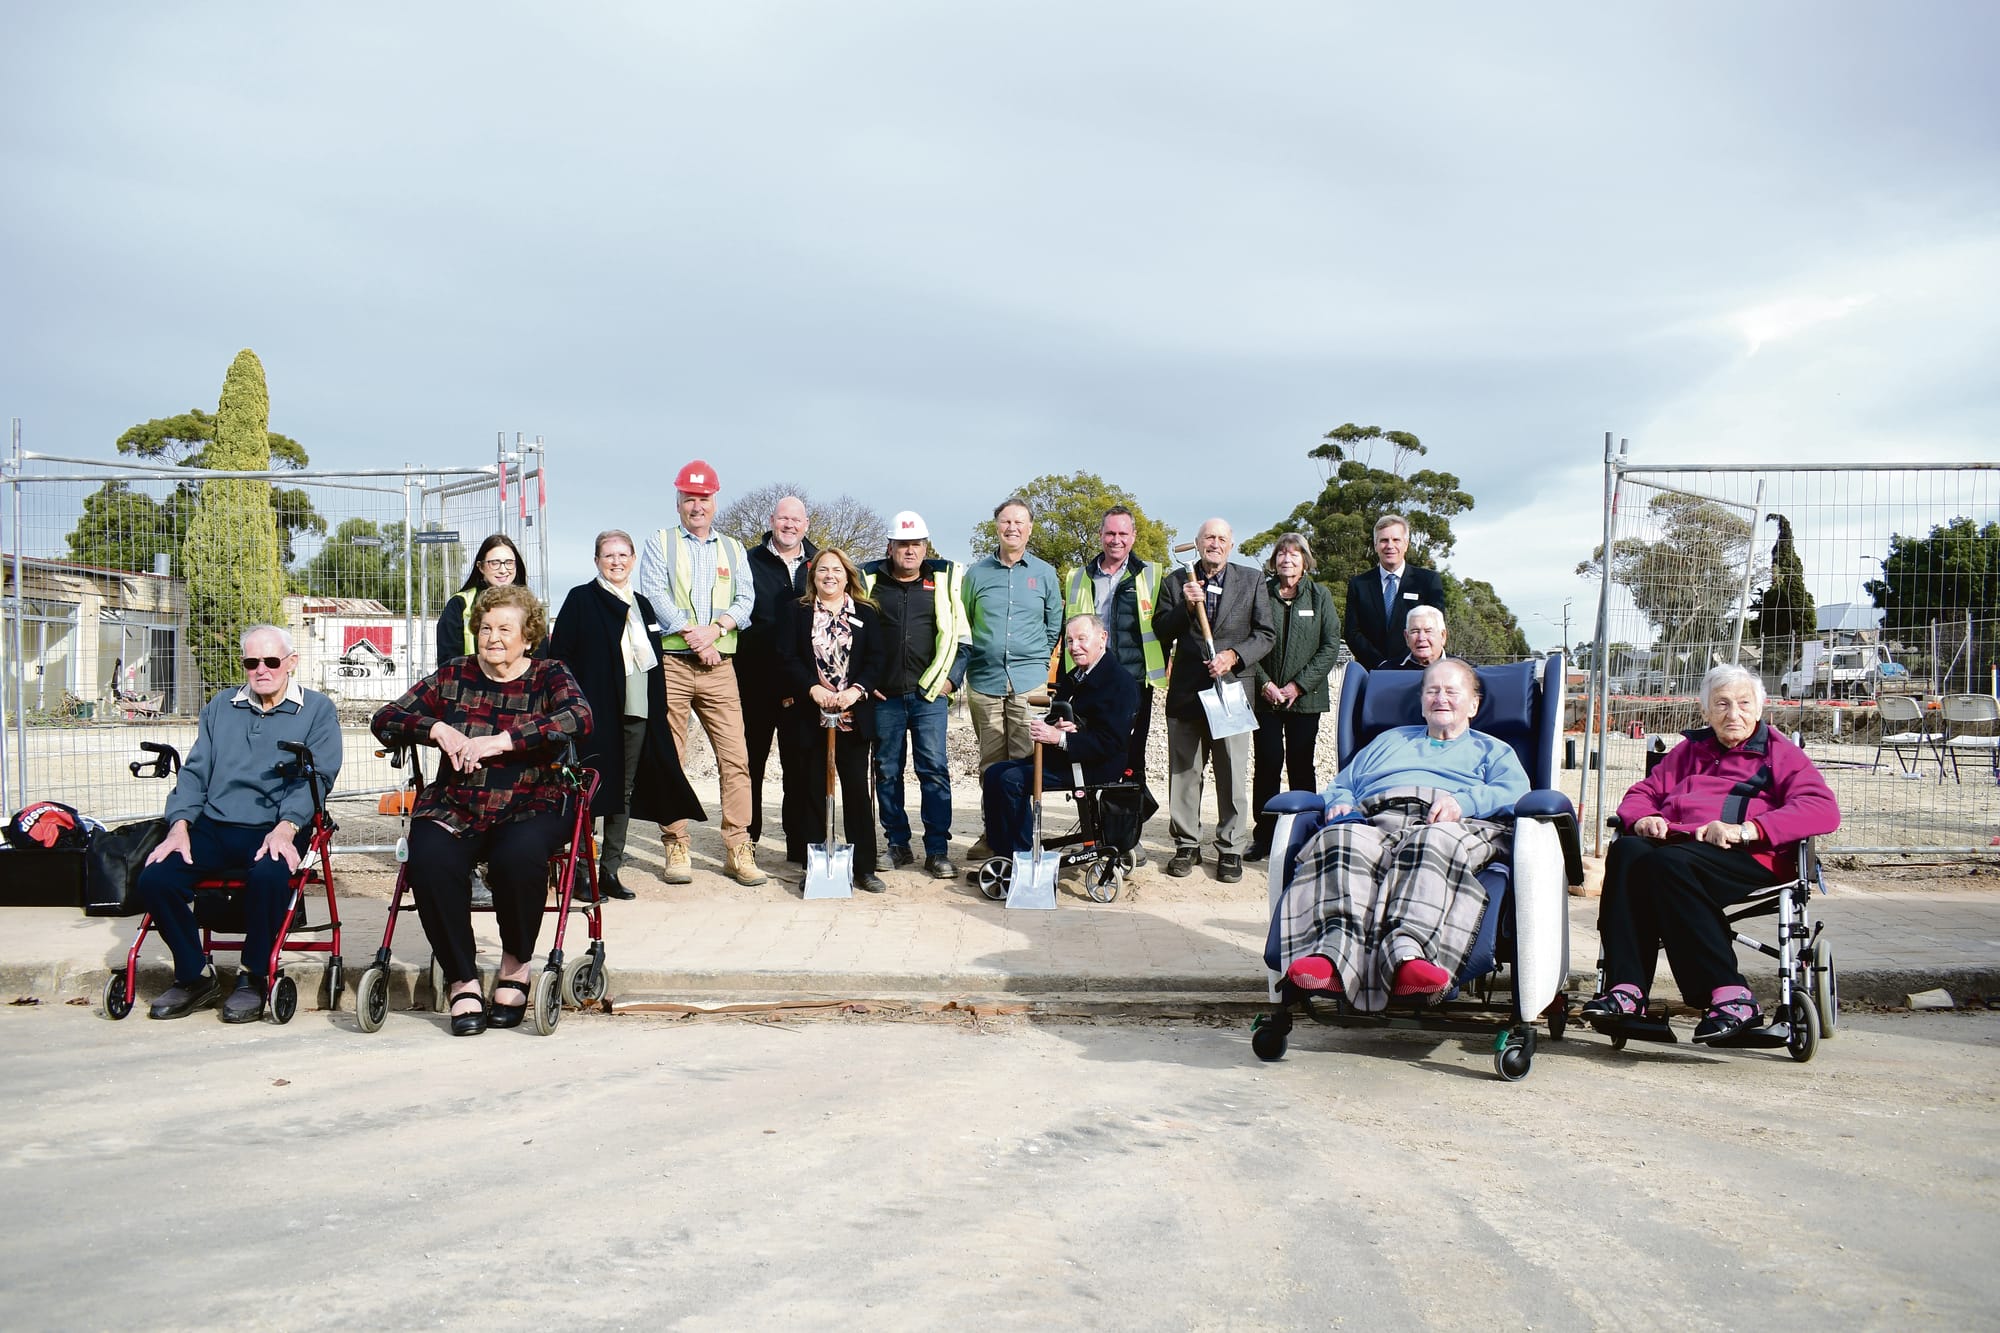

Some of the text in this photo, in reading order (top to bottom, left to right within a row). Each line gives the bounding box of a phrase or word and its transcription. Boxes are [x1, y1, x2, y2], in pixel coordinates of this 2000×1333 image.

[690, 473, 704, 483] M
[902, 521, 915, 529] M
[1076, 851, 1098, 862] aspire
